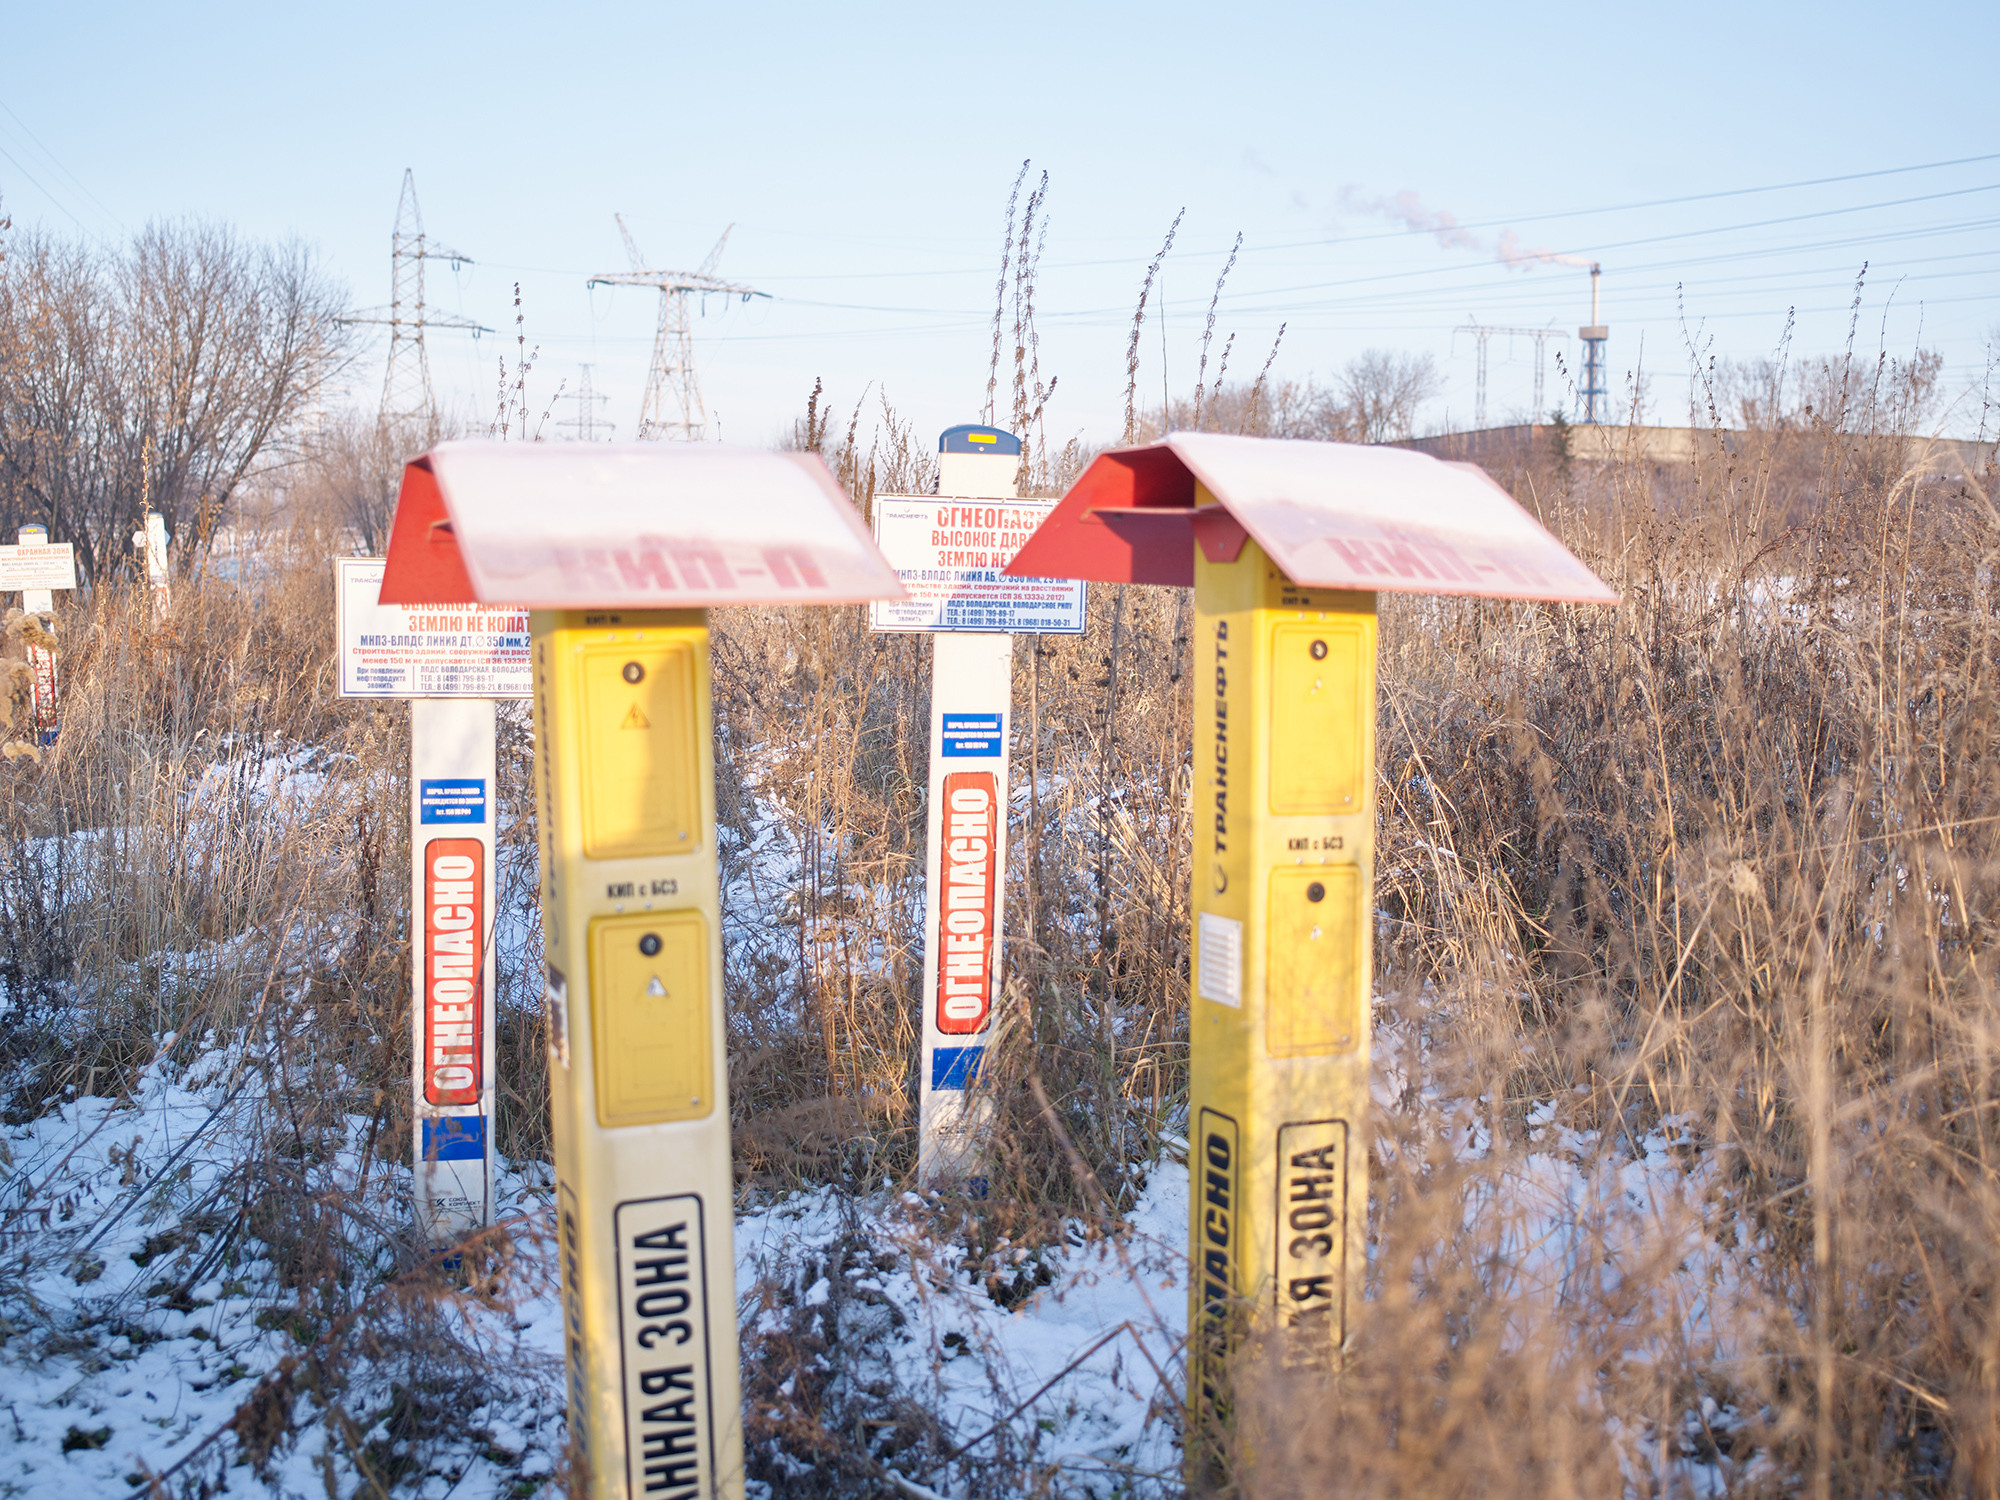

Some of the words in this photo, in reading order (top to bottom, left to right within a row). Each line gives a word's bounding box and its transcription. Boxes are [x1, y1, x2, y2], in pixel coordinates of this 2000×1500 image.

[931, 530, 996, 548] ВЫСОКОЕ
[1000, 532, 1033, 551] ДАВ
[938, 550, 988, 568] ЗЕМЛЮ
[991, 552, 1006, 568] НЕ
[954, 570, 982, 582] ЛИНИЯ
[951, 592, 998, 600] допускается
[947, 600, 964, 608] ЛПДС
[968, 609, 984, 617] (499)
[985, 609, 1015, 617] 799-89-17
[408, 615, 463, 632] ЗЕМЛЮ
[466, 615, 484, 632] НЕ
[487, 615, 530, 633] КОПАТ
[962, 617, 967, 625] 8
[968, 617, 984, 625] (499)
[1017, 618, 1022, 626] 8
[1040, 618, 1071, 627] 018-50-31
[360, 634, 424, 648] МНПЗ-ВЛПДС
[426, 635, 457, 647] ЛИНИЯ
[486, 635, 505, 648] 350
[524, 636, 531, 647] 2
[352, 647, 414, 655] Строительство
[449, 648, 499, 656] сооружений
[511, 649, 531, 657] расс
[424, 657, 476, 666] допускается
[492, 657, 532, 665] 36.13330.2
[357, 666, 369, 675] При
[370, 667, 405, 675] появлении
[420, 665, 439, 674] ЛПДС
[491, 666, 532, 674] ВОЛОДАРСК
[356, 675, 406, 683] нефтепродукта
[436, 674, 441, 682] 8
[442, 674, 461, 683] (499)
[462, 674, 494, 683] 799-89-17
[436, 683, 441, 691] 8
[442, 683, 461, 691] (499)
[497, 683, 502, 691] 8
[503, 683, 521, 691] (968)
[522, 683, 533, 691] 018
[1214, 619, 1228, 854] ТРАНСНЕФТЬ
[1288, 837, 1309, 850] КИП
[607, 882, 634, 898] КИП
[945, 786, 990, 1021] ОГНЕОПАСНО
[432, 854, 475, 1091] ОГНЕОПАСНО
[1289, 1143, 1336, 1258] ЗОНА
[633, 1220, 694, 1352] ЗОНА
